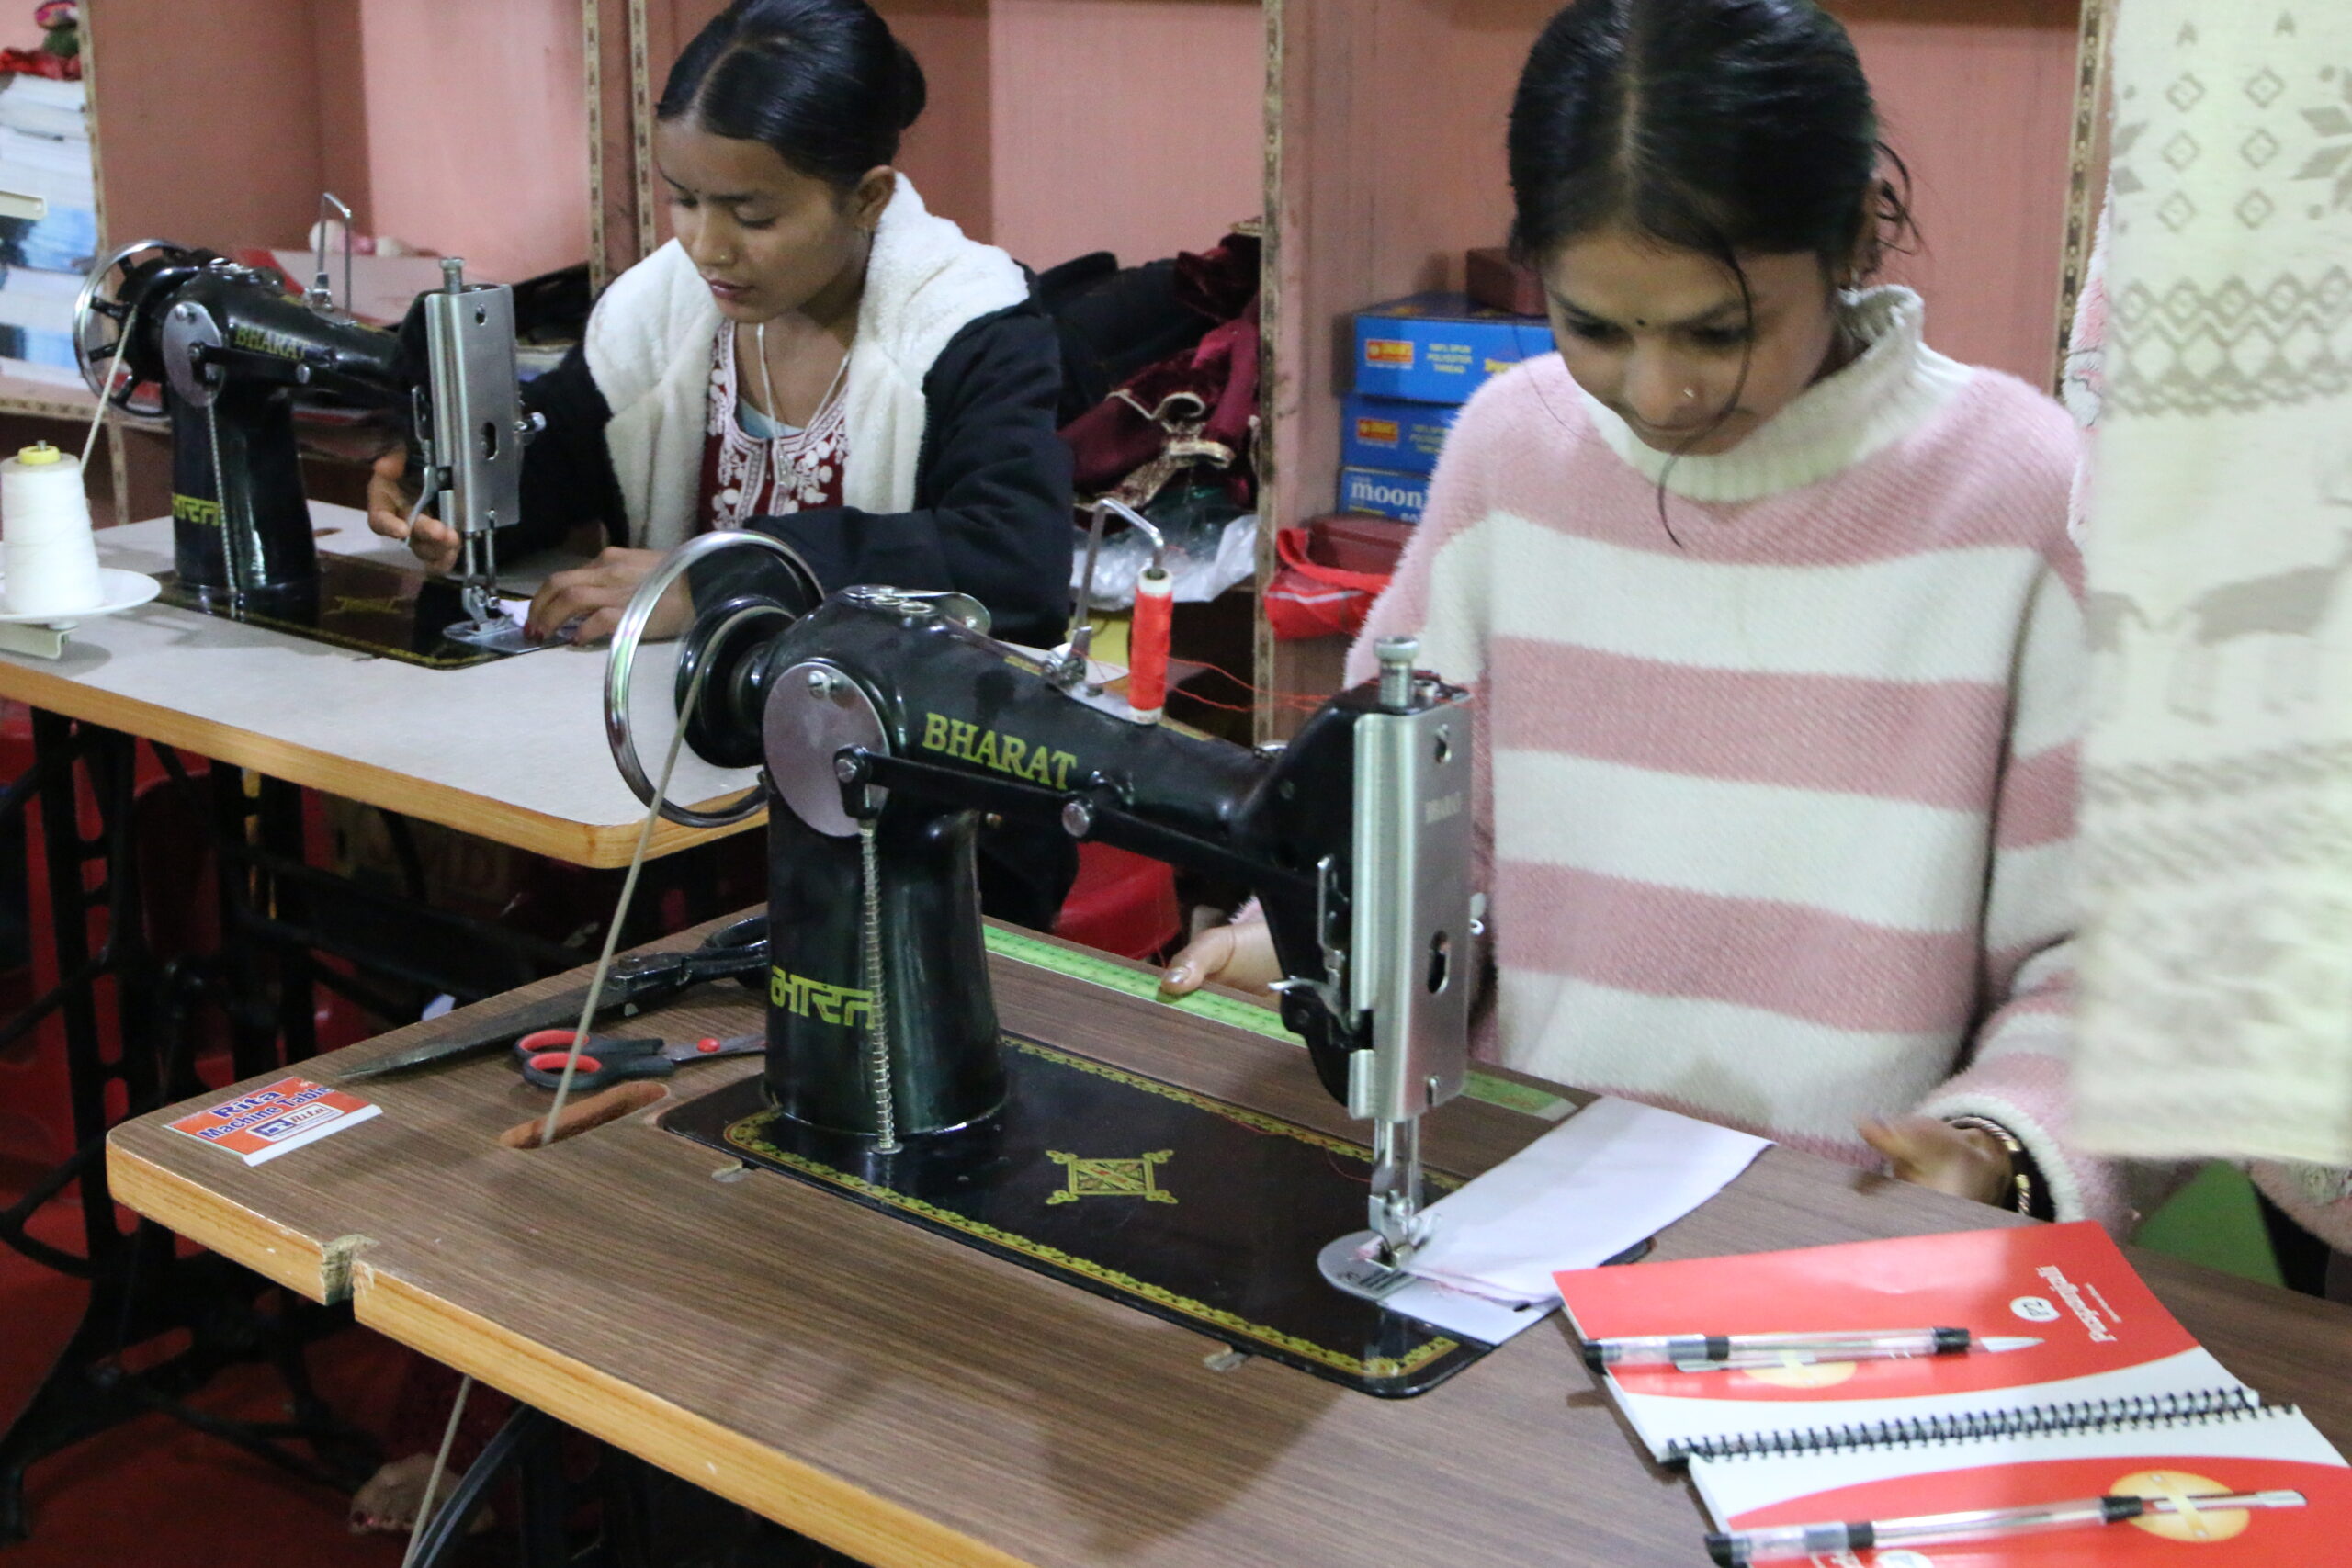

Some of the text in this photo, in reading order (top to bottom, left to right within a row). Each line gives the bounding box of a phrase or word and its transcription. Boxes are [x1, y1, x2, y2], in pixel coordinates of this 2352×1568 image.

[235, 326, 311, 360] BHARAT
[922, 712, 1078, 791] BHARAT
[771, 964, 875, 1030] भारत
[198, 1107, 282, 1139] Machine
[275, 1087, 330, 1107] Table
[210, 1091, 283, 1118] Rita
